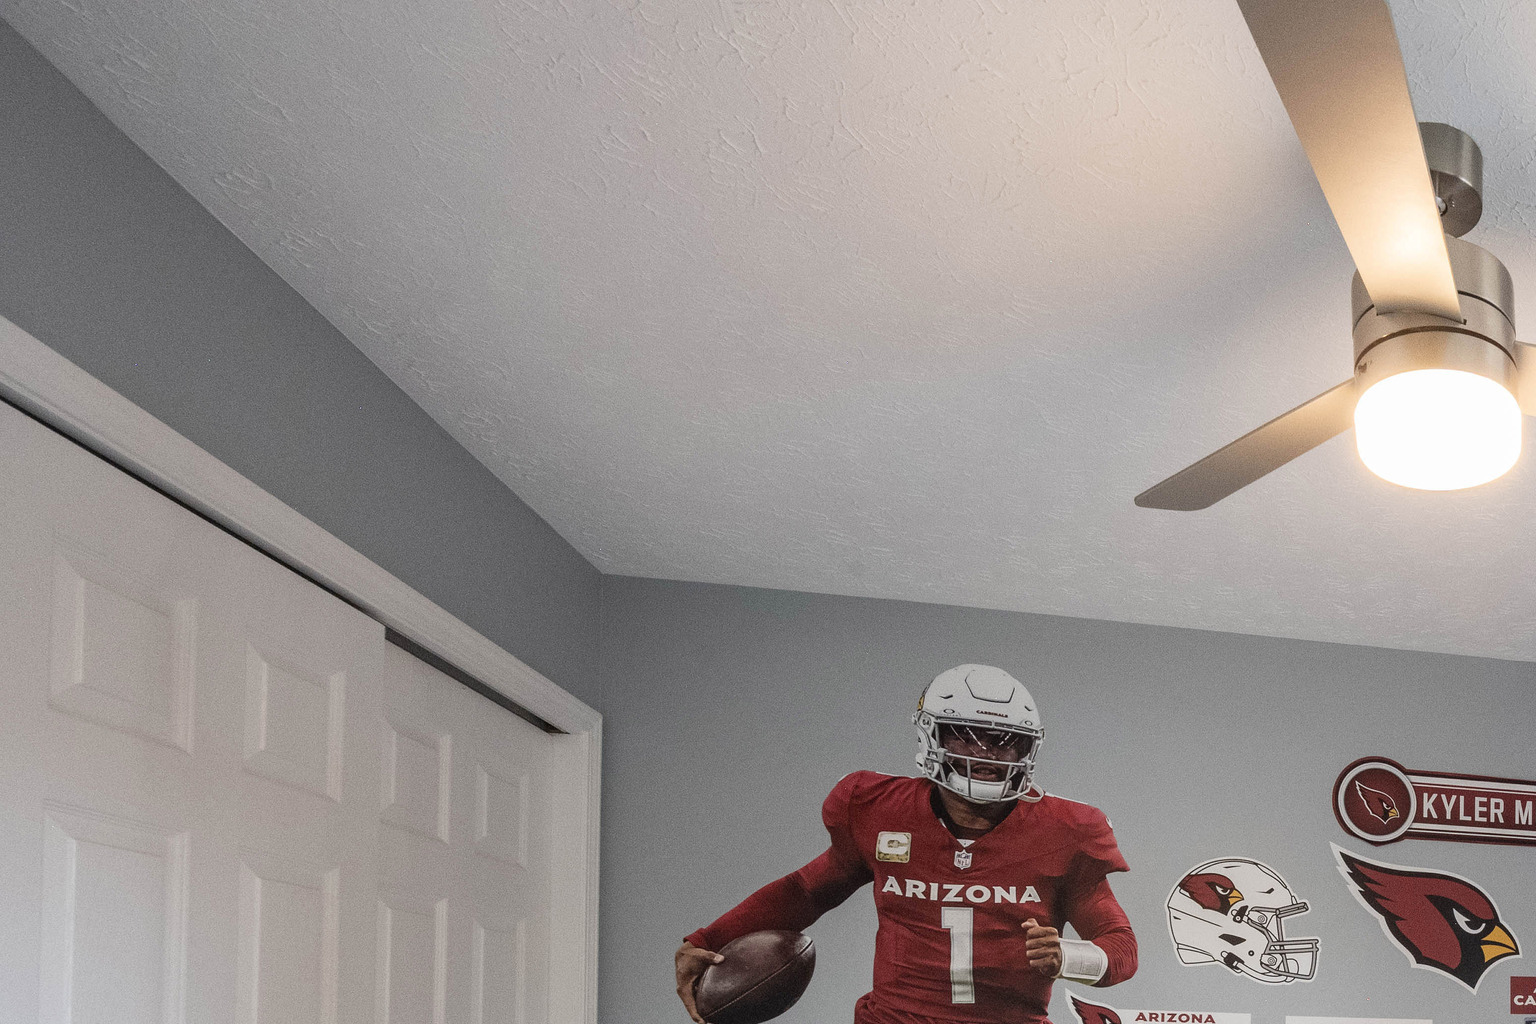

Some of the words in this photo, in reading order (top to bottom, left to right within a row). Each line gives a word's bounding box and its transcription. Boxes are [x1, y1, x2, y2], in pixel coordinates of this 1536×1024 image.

[1422, 792, 1505, 824] KYLER
[882, 876, 1041, 904] ARIZONA
[941, 906, 975, 1004] 1
[1135, 1012, 1216, 1024] ARIZONA
